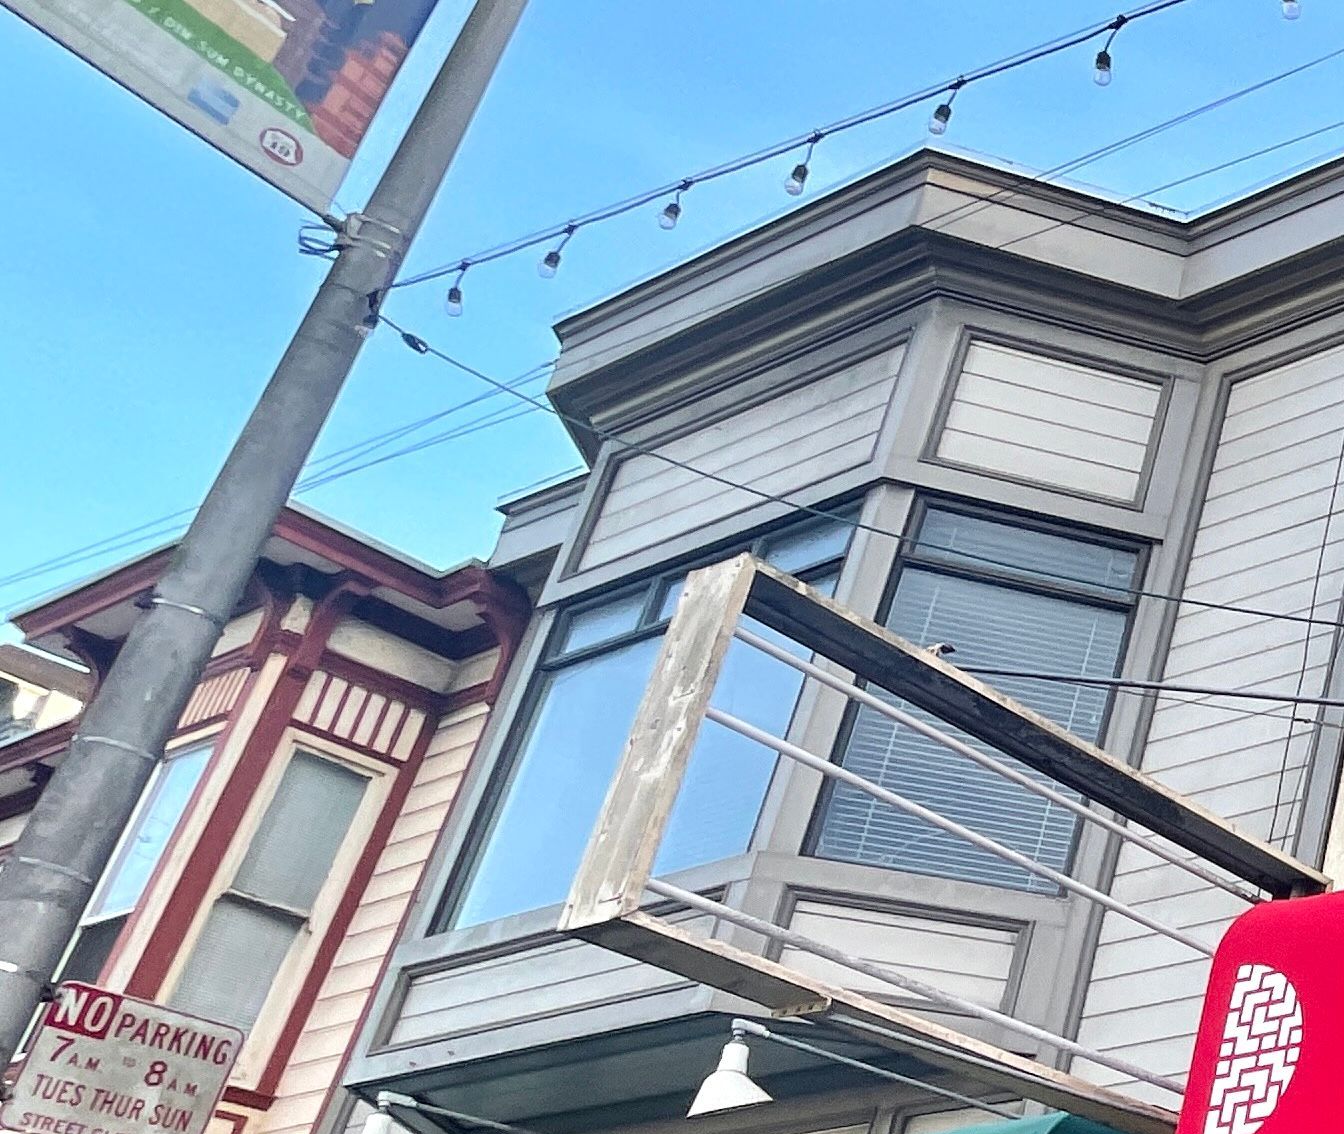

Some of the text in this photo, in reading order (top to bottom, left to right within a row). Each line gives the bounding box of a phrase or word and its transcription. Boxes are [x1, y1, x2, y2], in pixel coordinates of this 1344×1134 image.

[232, 65, 307, 120] DYNASTY
[54, 985, 233, 1066] NO PARKING
[31, 1073, 193, 1132] TUES THUR SUN
